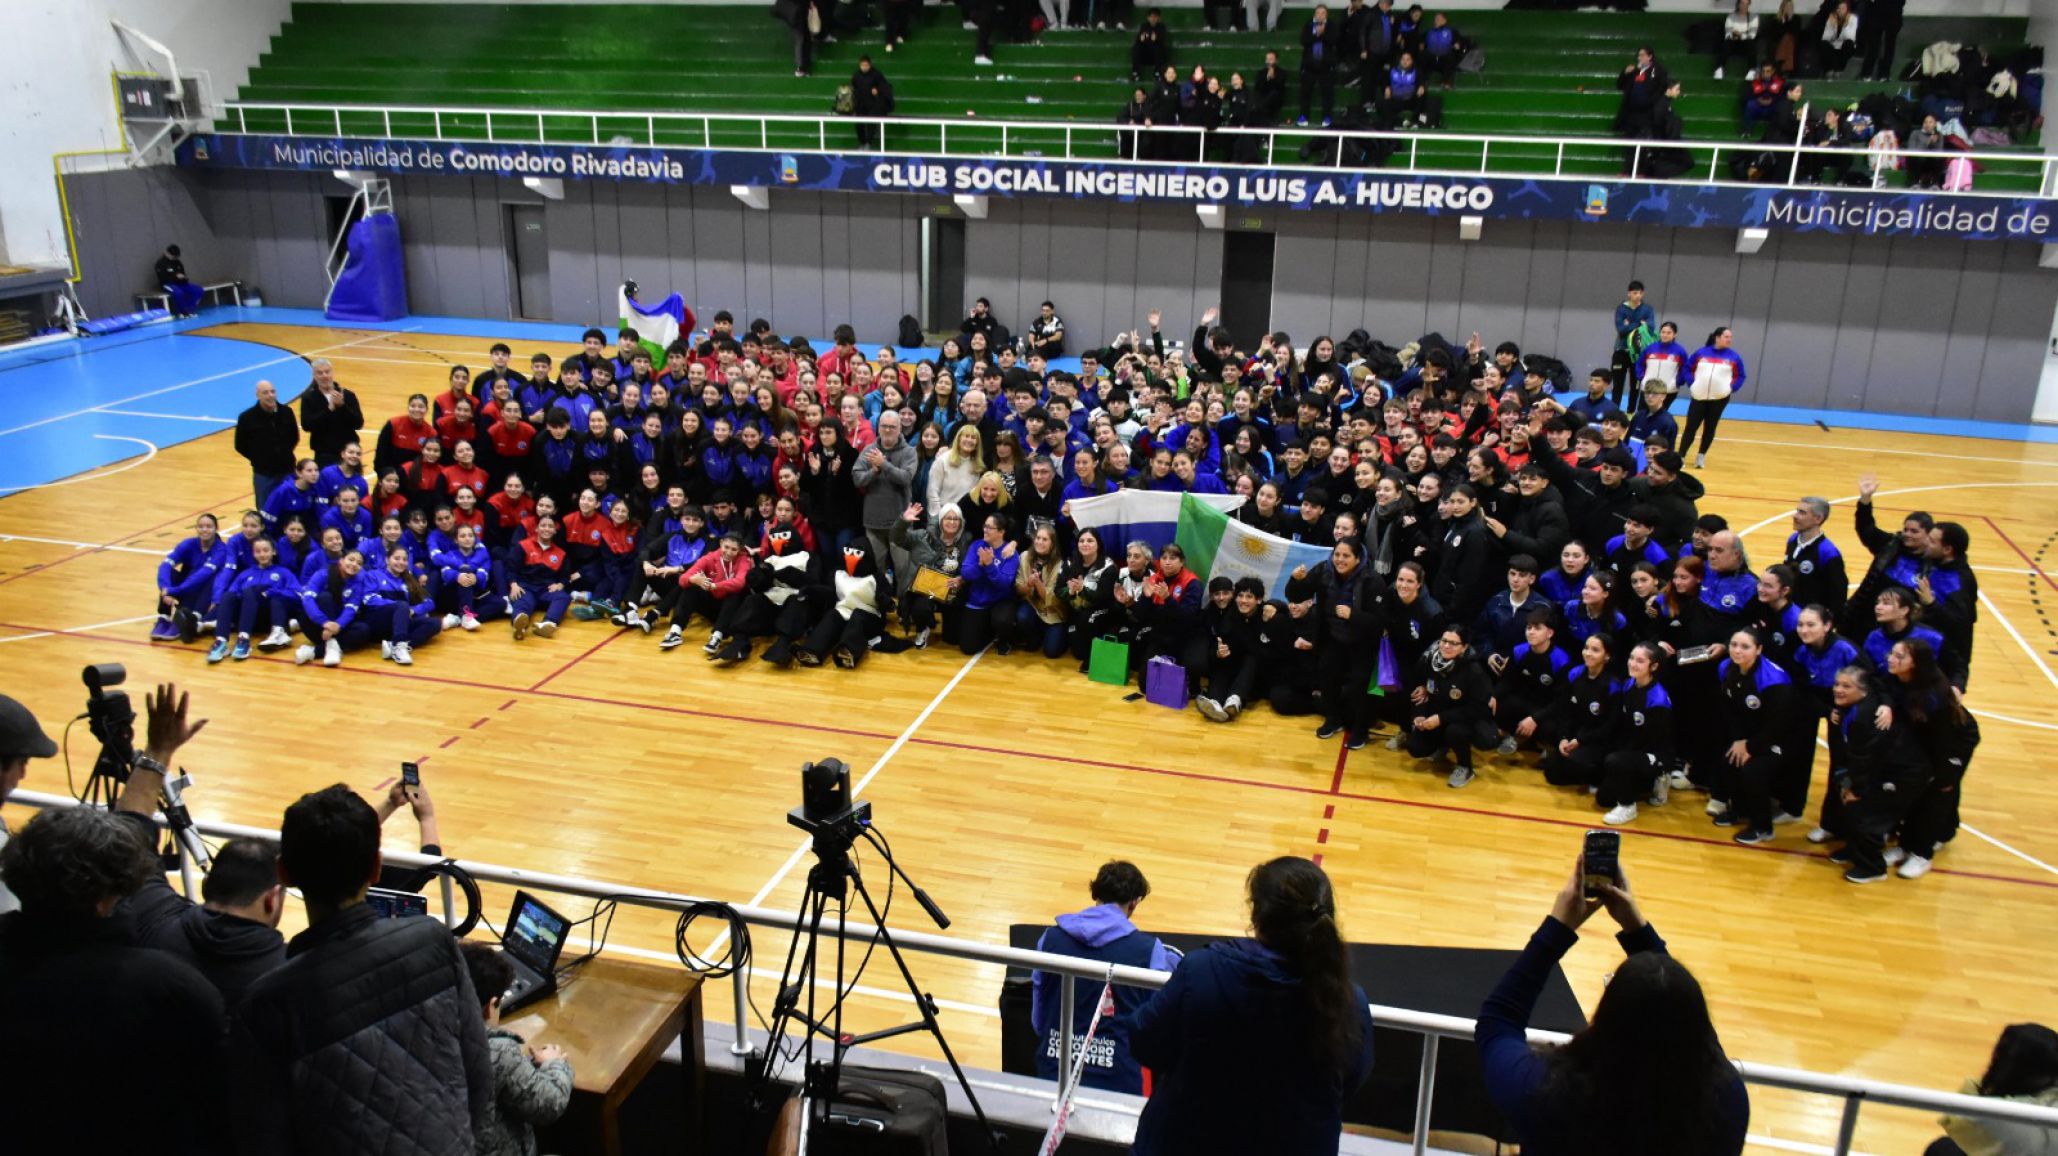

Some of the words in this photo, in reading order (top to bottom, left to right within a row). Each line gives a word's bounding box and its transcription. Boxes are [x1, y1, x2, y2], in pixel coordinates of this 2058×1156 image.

[273, 143, 413, 170] Municipalidad
[418, 148, 444, 168] de
[450, 150, 566, 174] Comodoro
[571, 155, 684, 179] Rivadavia
[874, 163, 948, 188] CLUB
[954, 166, 1062, 193] SOCIAL
[1065, 170, 1229, 199] INGENIERO
[1238, 178, 1306, 203] LUIS
[1313, 181, 1347, 205] A.
[1356, 182, 1493, 211] HUERGO
[1765, 199, 1999, 234] Municipalidad
[2006, 208, 2050, 234] de
[1046, 1046, 1114, 1068] DEORTES
[1048, 1037, 1115, 1057] COOORO
